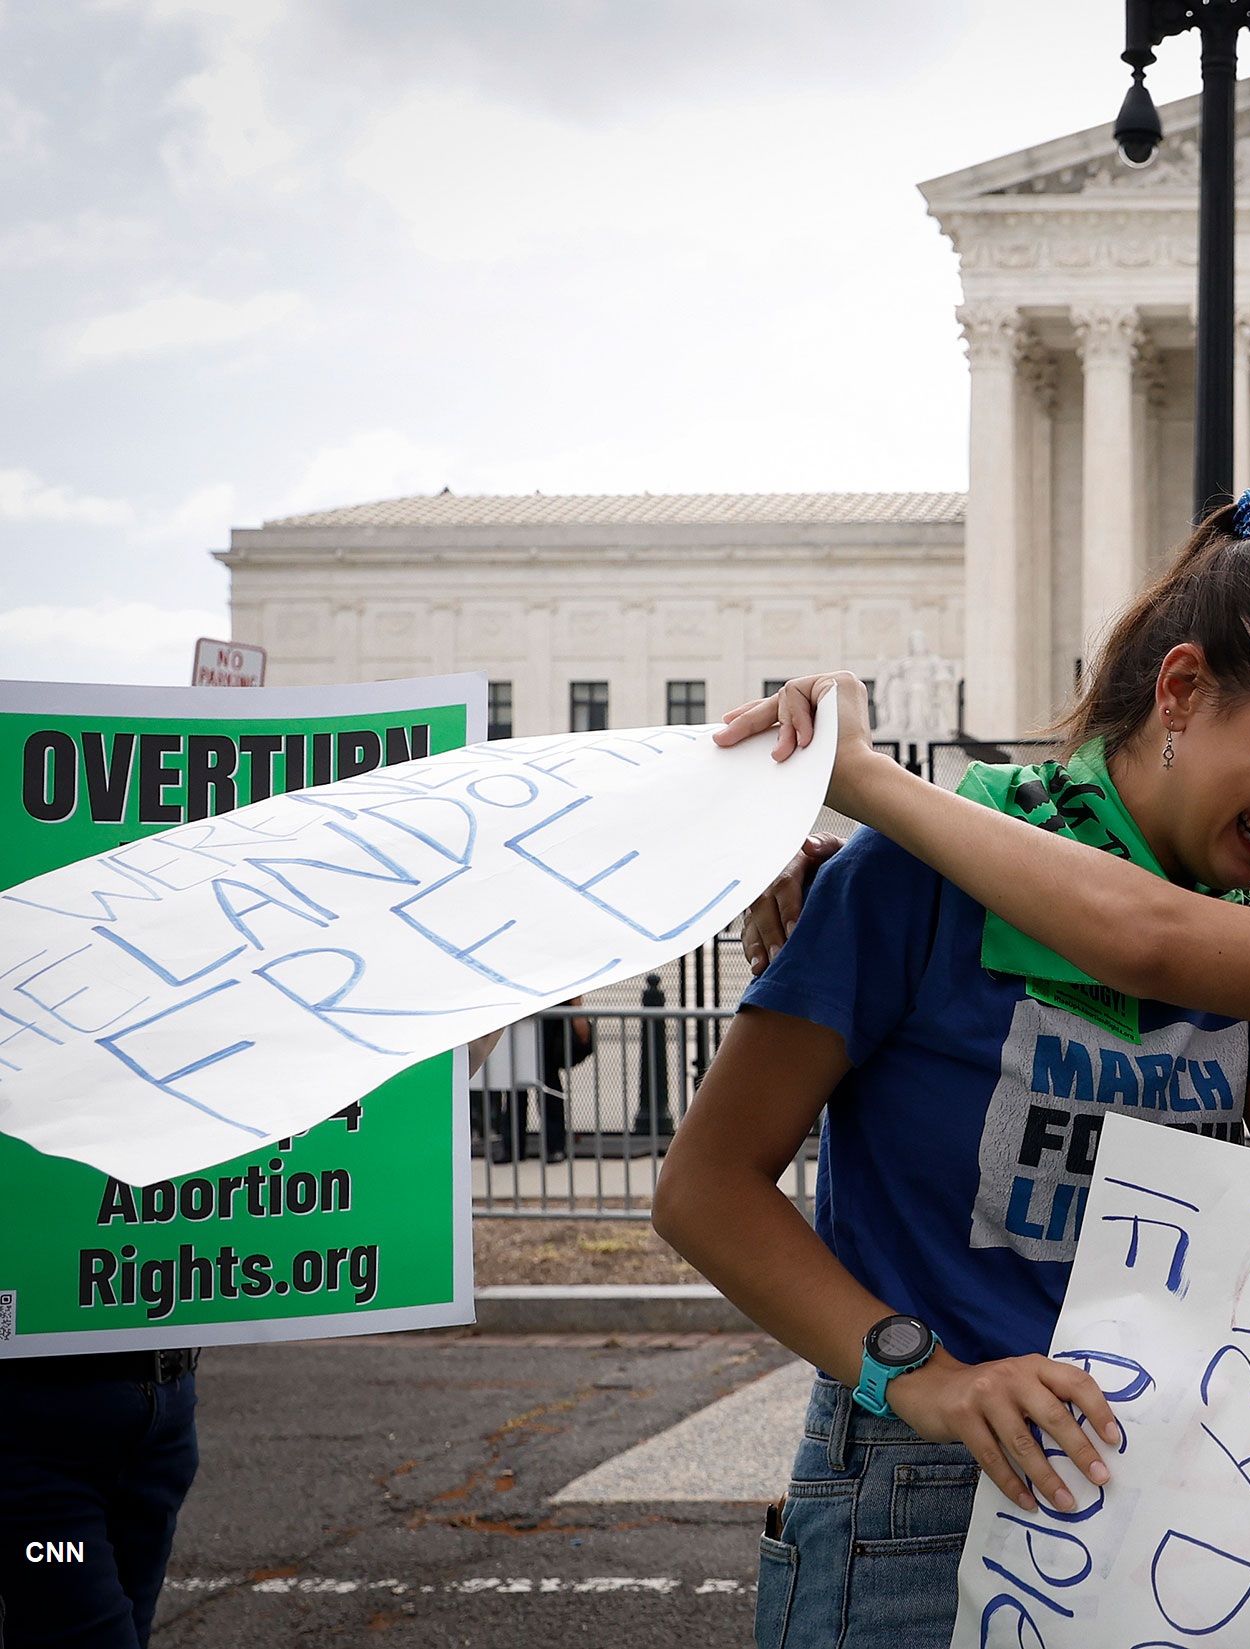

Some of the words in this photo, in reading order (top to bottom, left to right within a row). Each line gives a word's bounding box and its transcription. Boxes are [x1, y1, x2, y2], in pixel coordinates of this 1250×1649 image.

[217, 650, 244, 671] NO
[283, 733, 607, 821] NEVE
[91, 796, 477, 987] LAND
[465, 750, 578, 809] OF
[94, 795, 741, 1138] FREE
[1030, 1034, 1235, 1112] MARCH
[1017, 1103, 1104, 1176] FO
[96, 1157, 352, 1225] Abortion
[1101, 1177, 1200, 1300] IF
[78, 1243, 379, 1320] Rights.org
